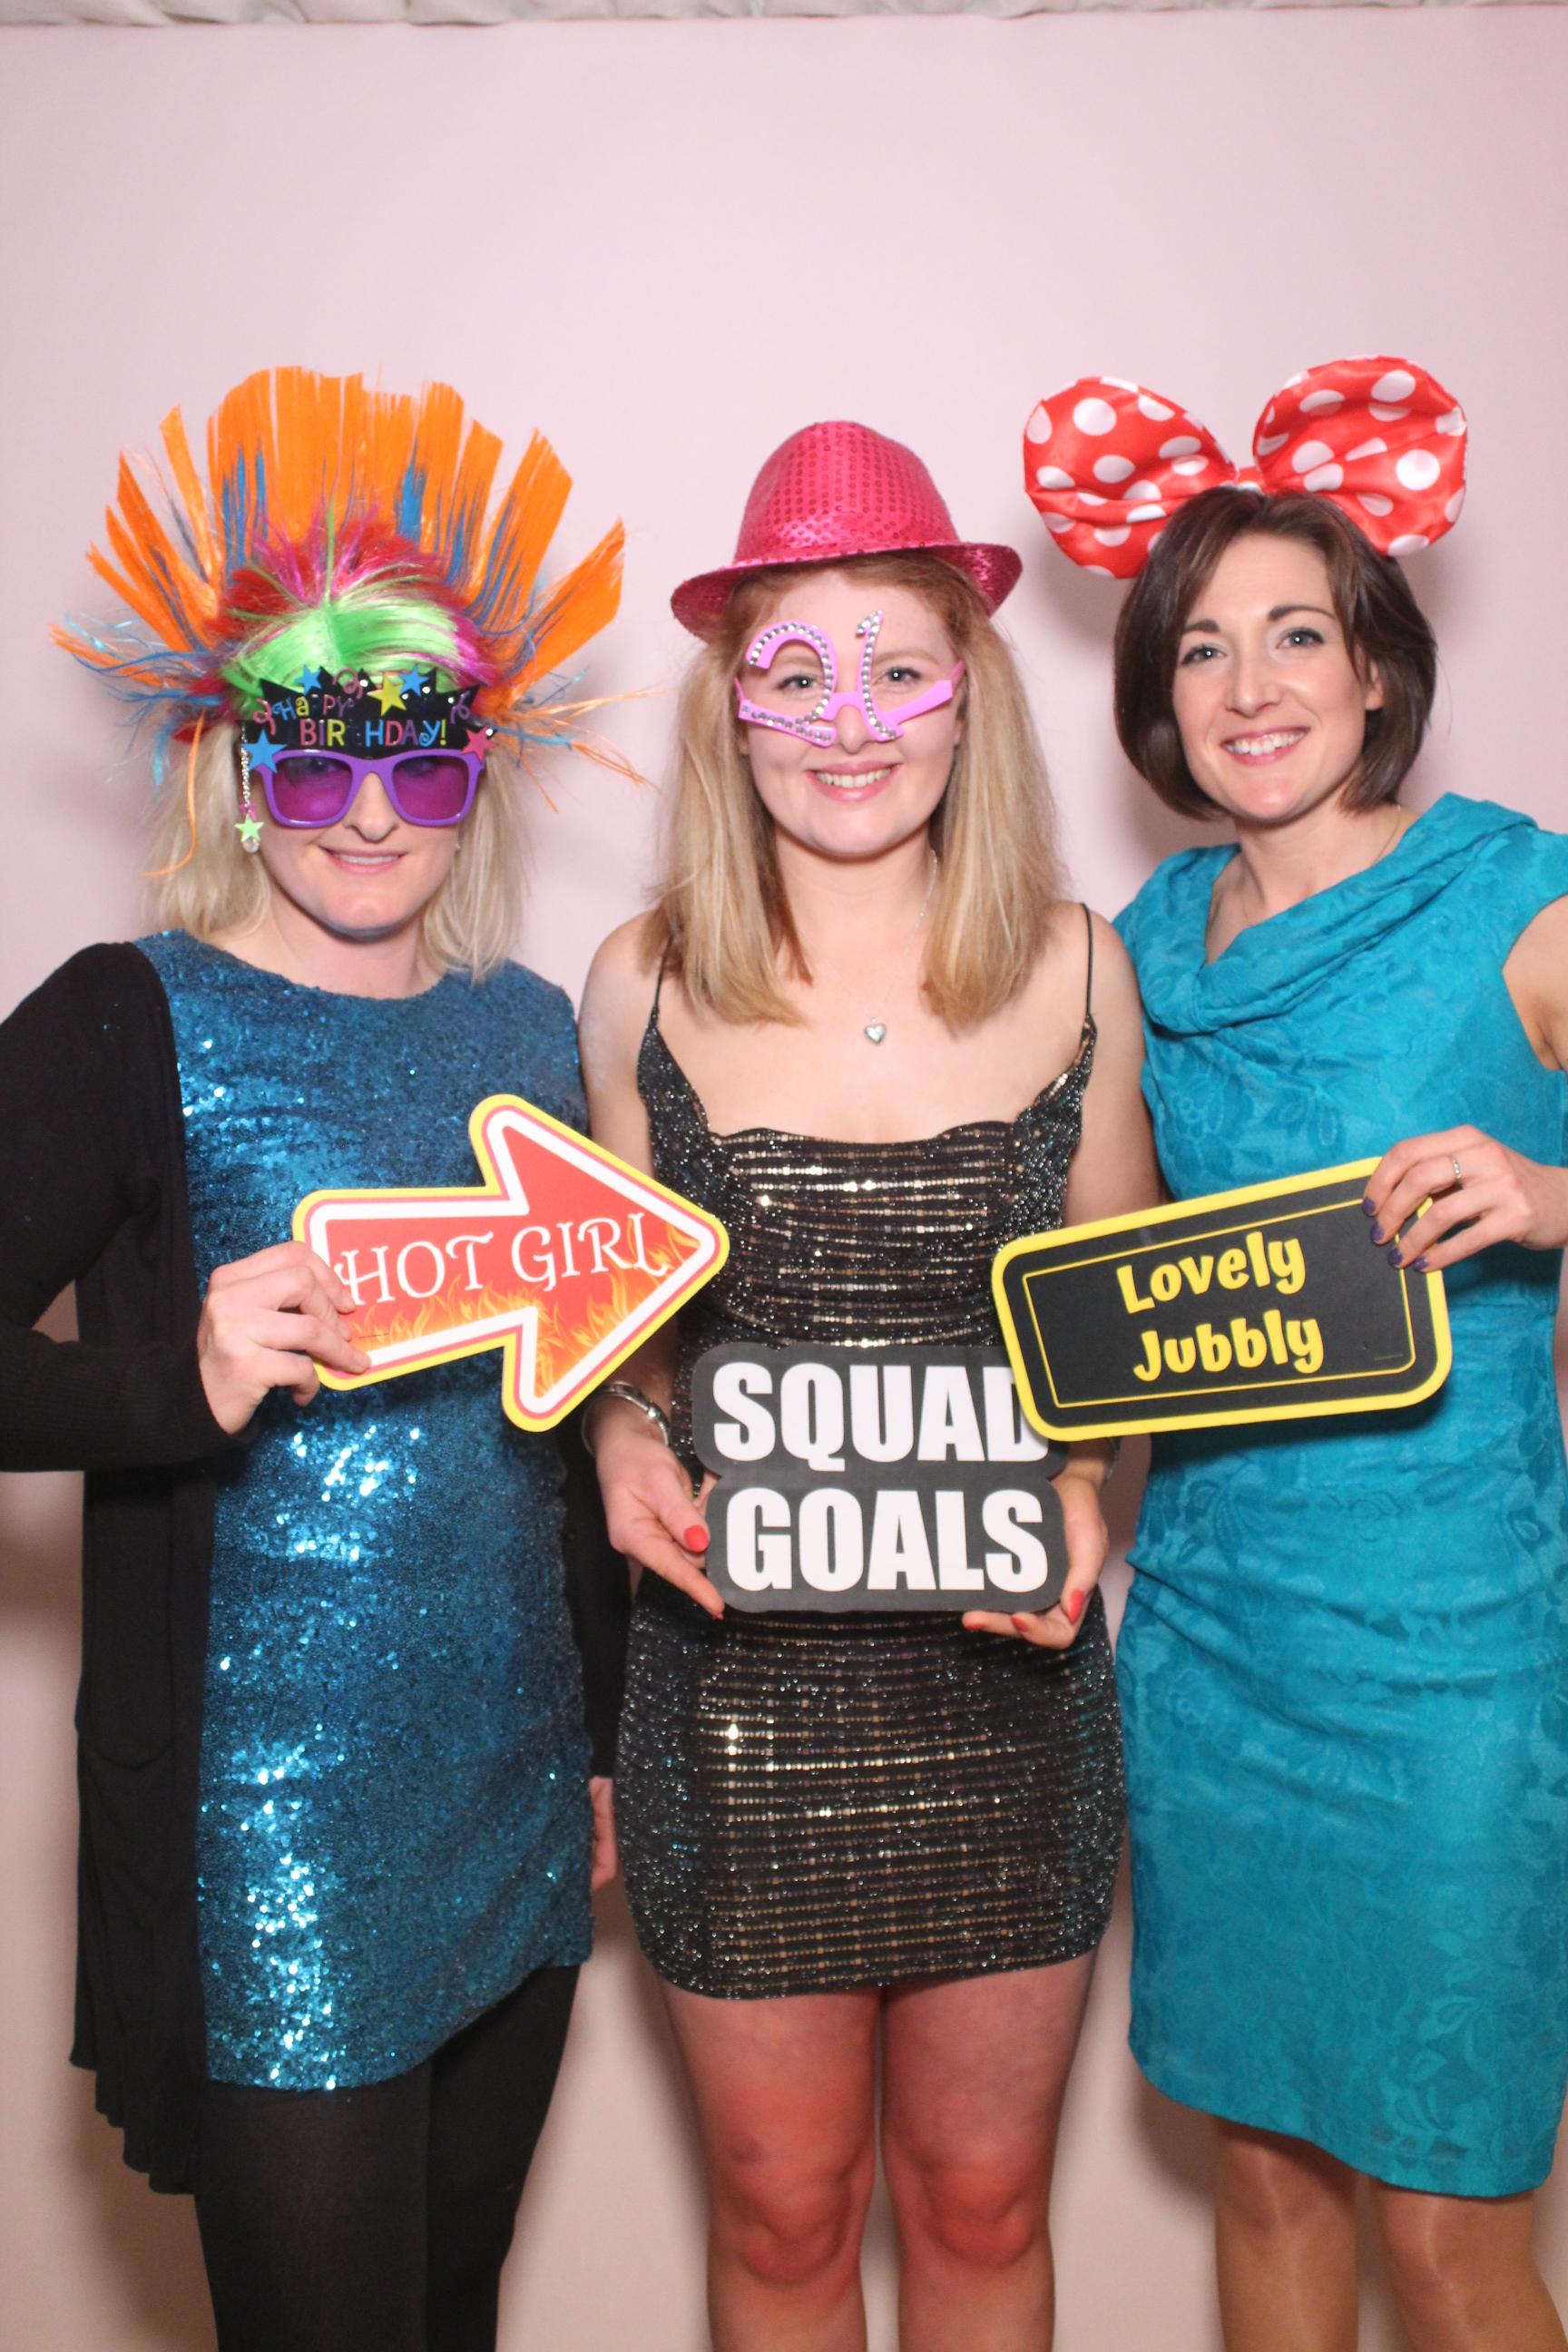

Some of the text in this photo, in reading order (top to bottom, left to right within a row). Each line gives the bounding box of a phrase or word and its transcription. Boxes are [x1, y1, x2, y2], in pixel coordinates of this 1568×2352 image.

[299, 719, 447, 748] BIRHDAY!
[334, 1211, 669, 1307] HOT GIRL
[1116, 1231, 1307, 1314] Lovely
[1132, 1309, 1325, 1382] Jubbly
[712, 1361, 1050, 1472] SQUAD
[726, 1487, 1049, 1593] GOALS
